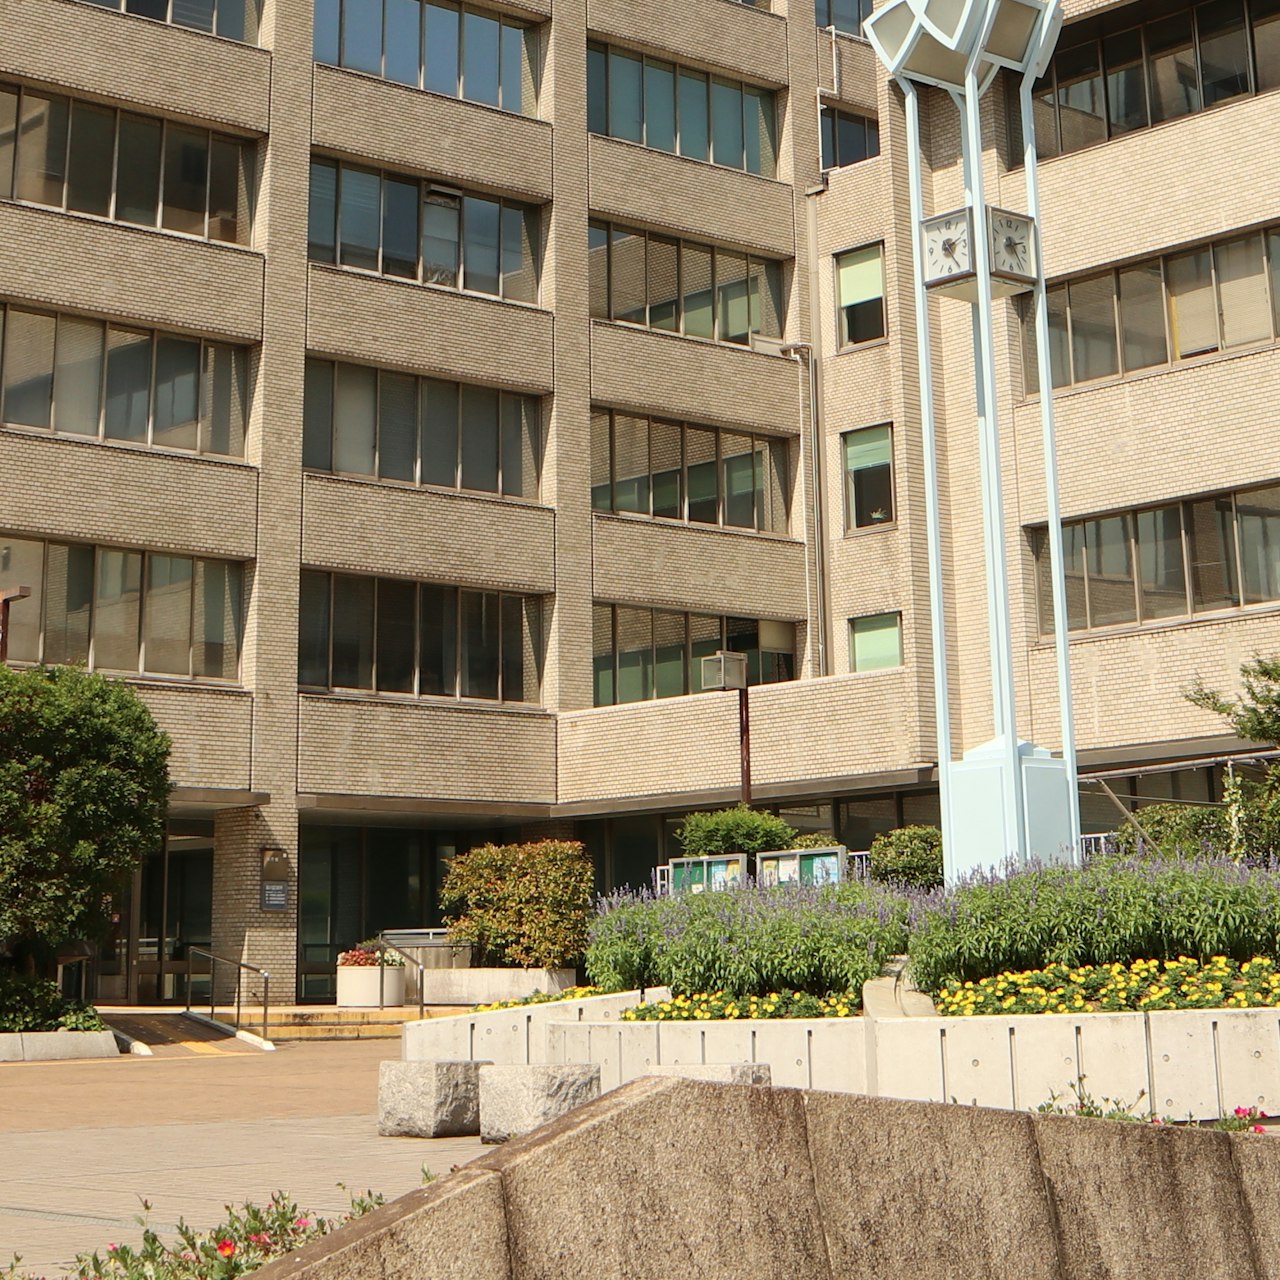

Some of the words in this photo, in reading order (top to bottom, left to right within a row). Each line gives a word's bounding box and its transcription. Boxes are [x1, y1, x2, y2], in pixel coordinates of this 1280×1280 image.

[944, 220, 951, 230] 12
[1006, 219, 1013, 229] 12
[928, 247, 934, 256] 9
[947, 264, 953, 274] 6
